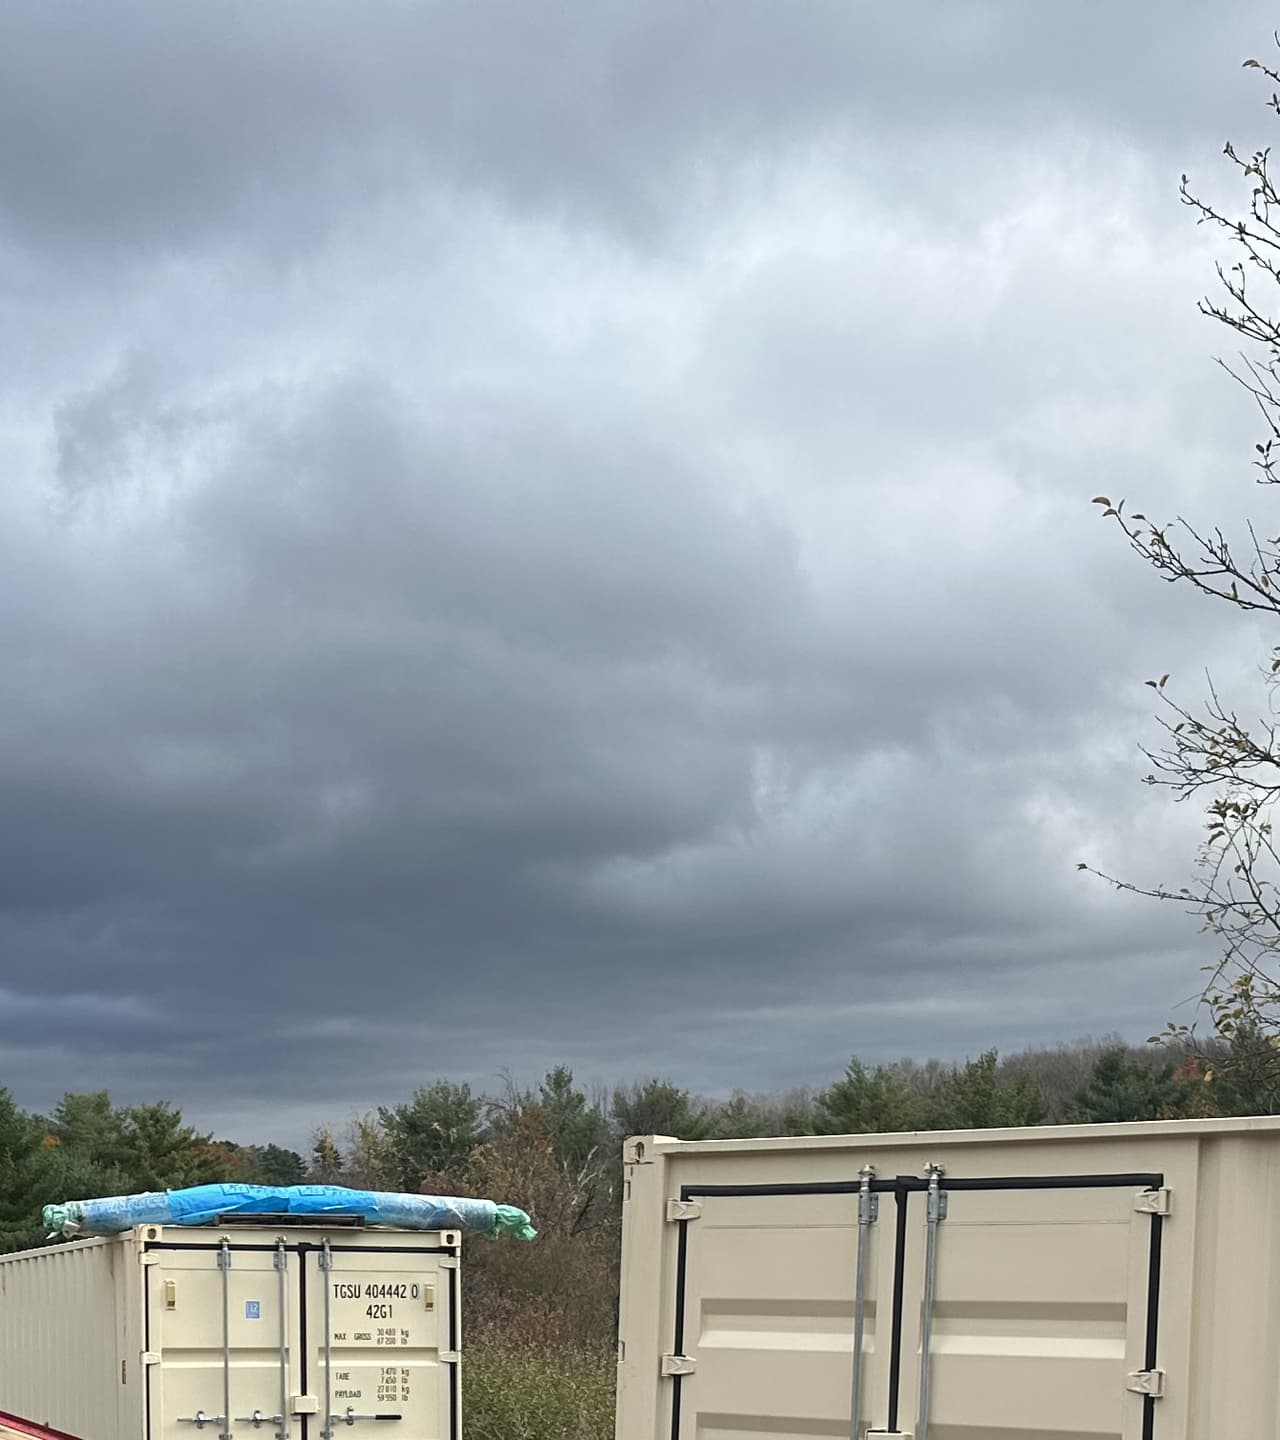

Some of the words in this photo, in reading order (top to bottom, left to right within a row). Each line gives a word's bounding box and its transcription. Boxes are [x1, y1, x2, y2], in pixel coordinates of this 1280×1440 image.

[333, 1284, 361, 1299] TGSU
[365, 1284, 407, 1299] 404442
[411, 1284, 418, 1299] 0
[366, 1305, 393, 1318] 42G1
